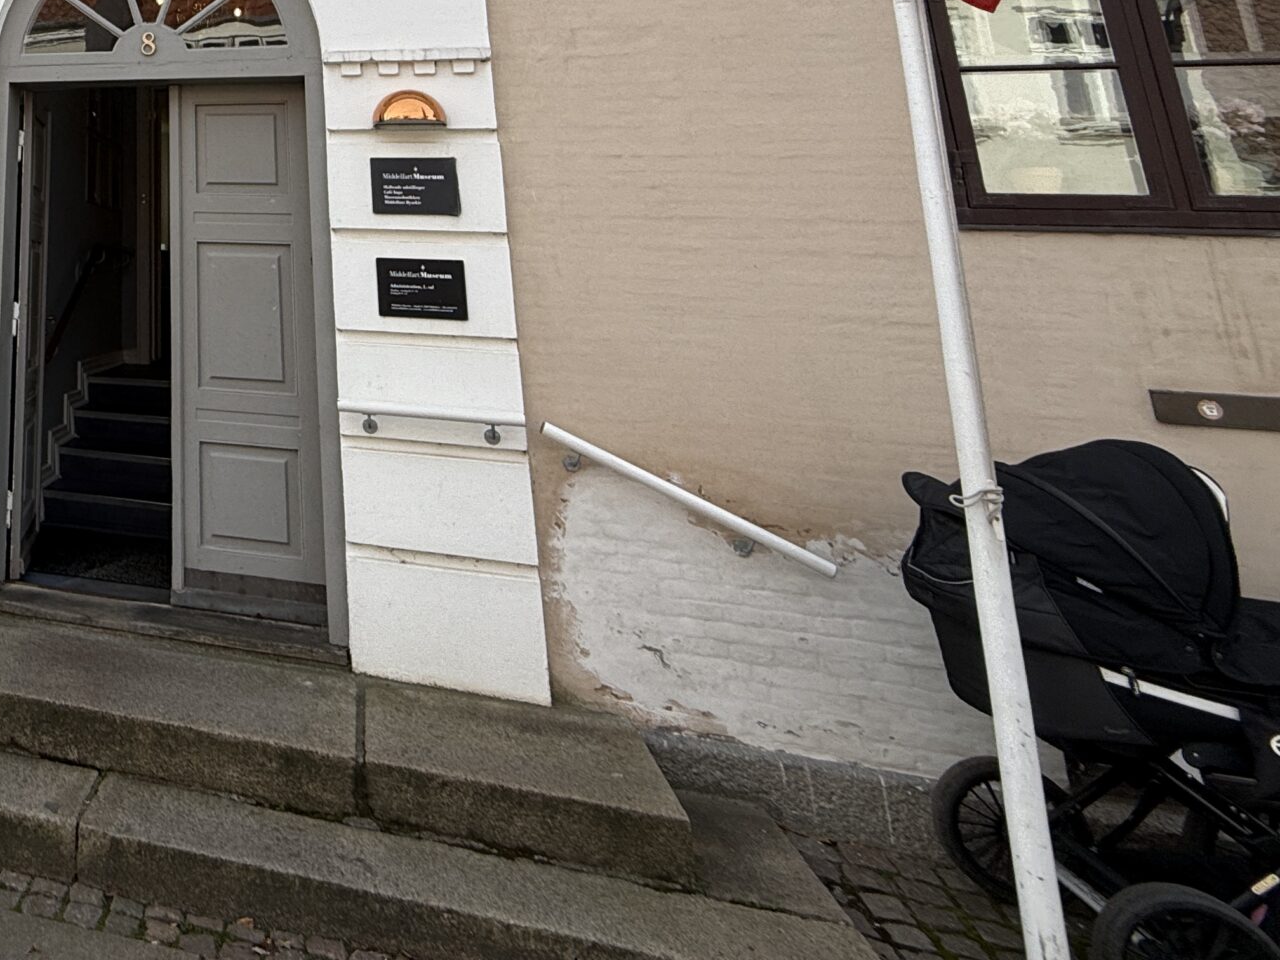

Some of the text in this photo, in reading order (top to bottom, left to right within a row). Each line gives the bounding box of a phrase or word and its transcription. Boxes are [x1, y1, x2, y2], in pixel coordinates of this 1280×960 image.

[141, 31, 156, 55] 8
[382, 172, 445, 180] Middelfart Museum
[389, 270, 453, 280] Middelfart Museum
